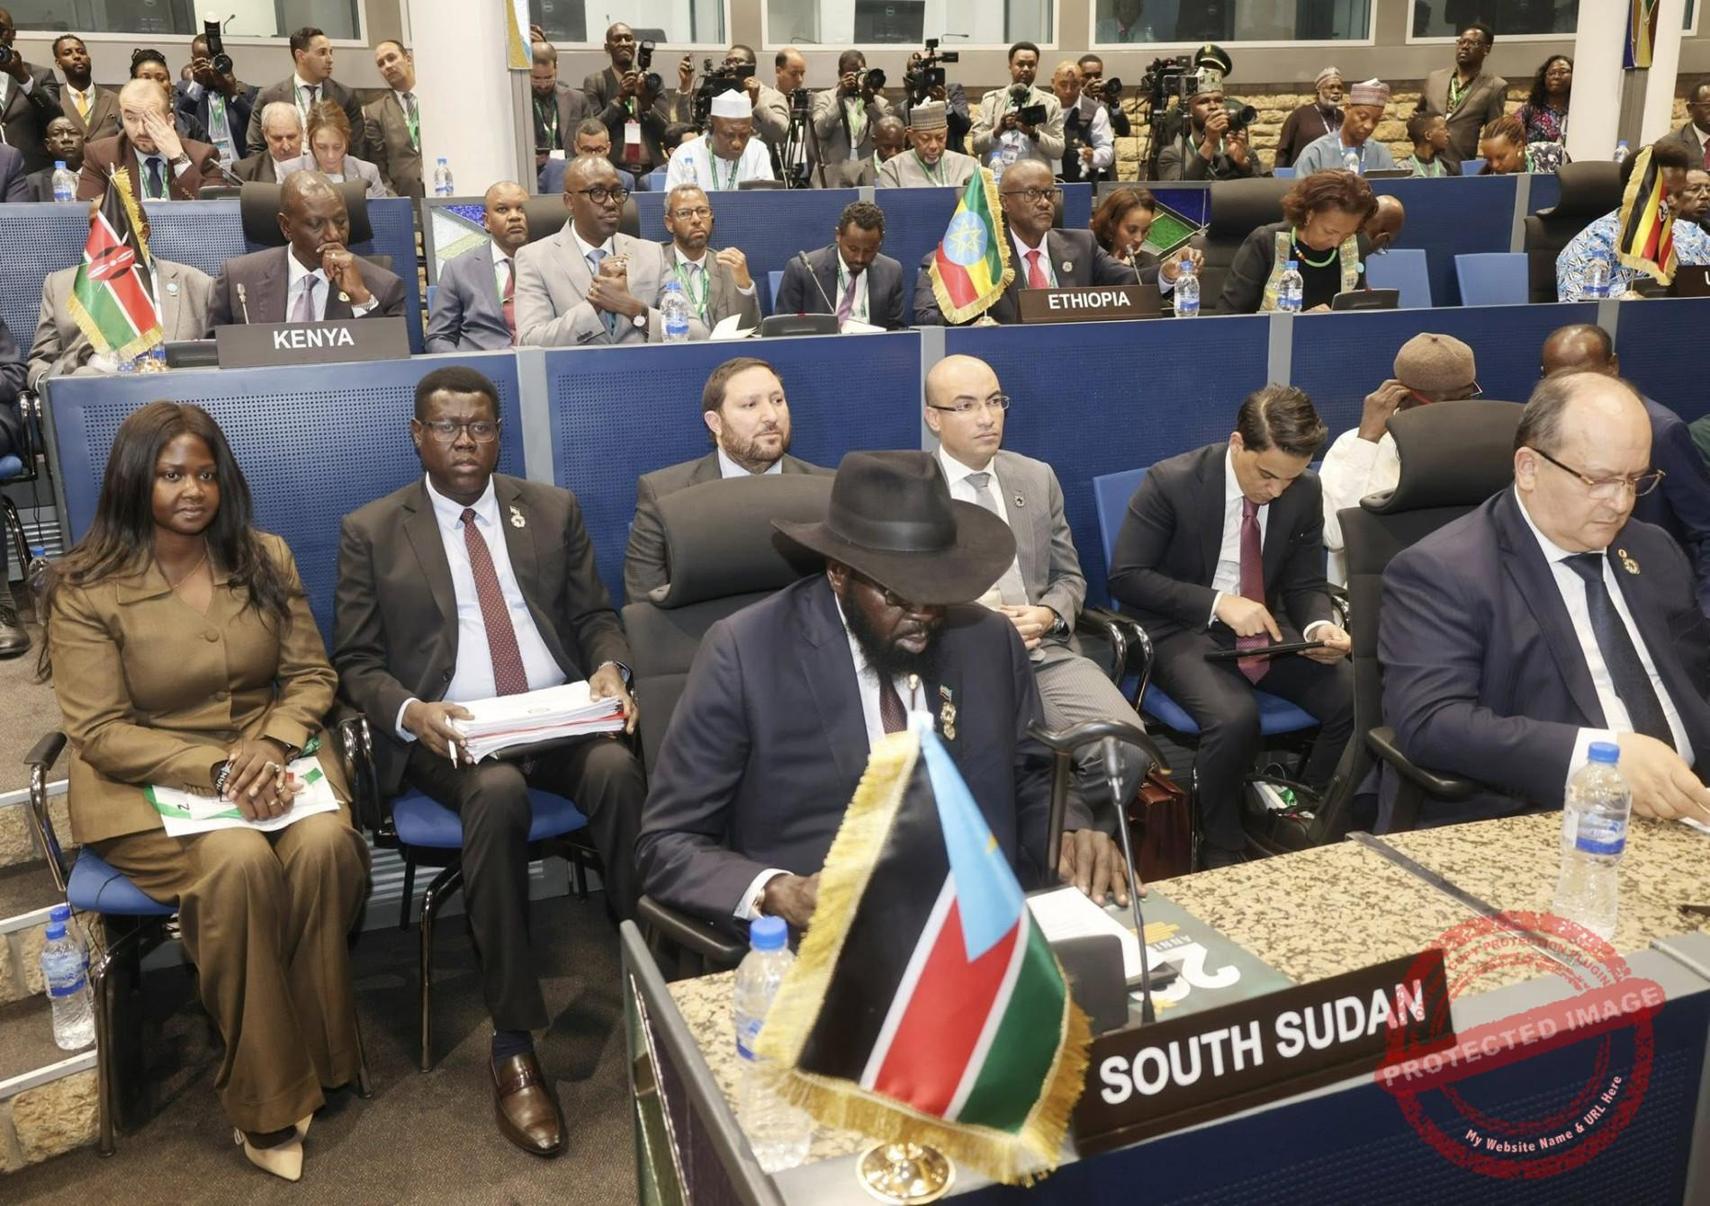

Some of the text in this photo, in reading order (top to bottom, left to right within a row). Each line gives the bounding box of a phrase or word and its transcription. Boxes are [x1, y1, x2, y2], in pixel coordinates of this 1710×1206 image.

[1048, 291, 1131, 309] ETHIOPIA
[273, 327, 355, 349] KENYA
[1100, 1019, 1265, 1105] SOUTH
[1275, 979, 1426, 1058] SUDAN
